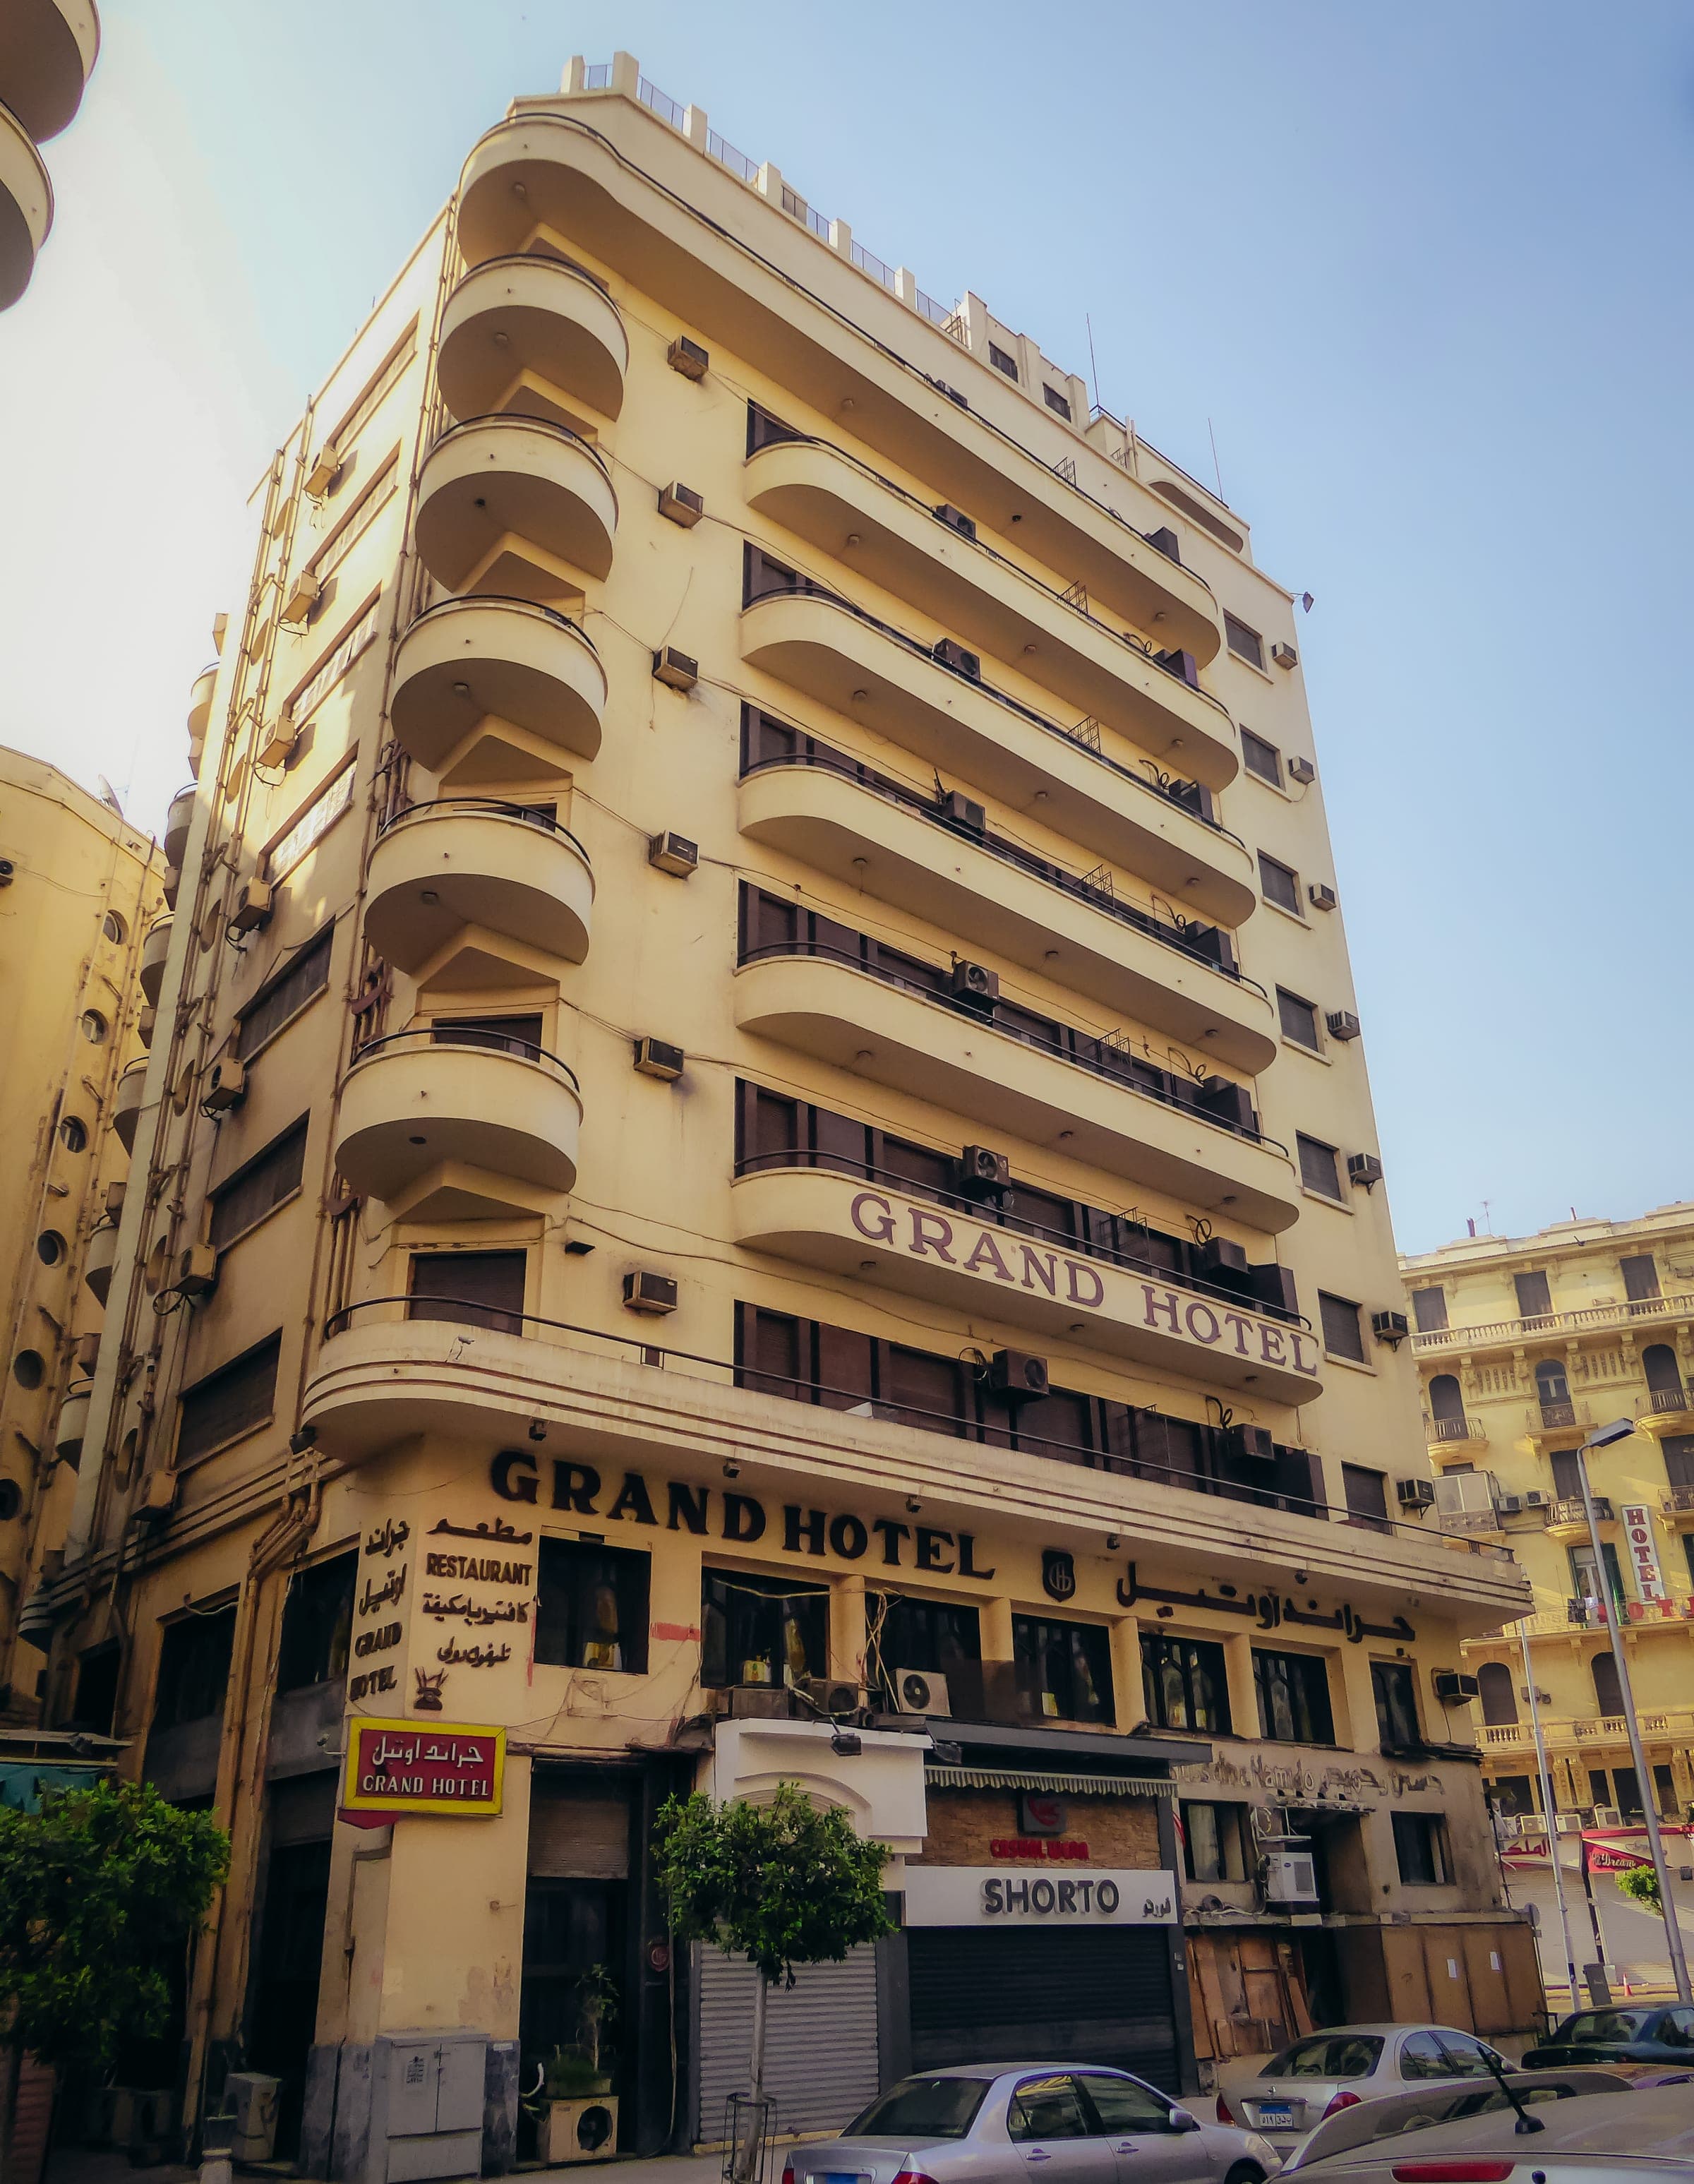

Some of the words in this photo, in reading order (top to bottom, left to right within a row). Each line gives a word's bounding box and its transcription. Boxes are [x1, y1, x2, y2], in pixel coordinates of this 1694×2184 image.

[851, 1192, 1106, 1307] GRAND
[1140, 1284, 1318, 1376] HOTEL
[426, 1517, 533, 1545] مطعم
[491, 1451, 767, 1542] GRAND
[782, 1505, 995, 1580] HOTEL
[365, 1518, 410, 1557] جراند
[1624, 1508, 1661, 1601] HOTEL
[426, 1552, 533, 1586] RESTAURANT
[359, 1563, 407, 1616] اوتيل
[355, 1621, 403, 1658] GRAND
[1283, 1597, 1416, 1657] جراند
[349, 1665, 398, 1702] HOTEL
[371, 1735, 421, 1767] اوتيل
[423, 1741, 484, 1769] جراند
[362, 1774, 424, 1794] GRAND
[431, 1777, 489, 1796] HOTEL
[1601, 1853, 1636, 1868] Dream
[981, 1878, 1119, 1914] SHORTO
